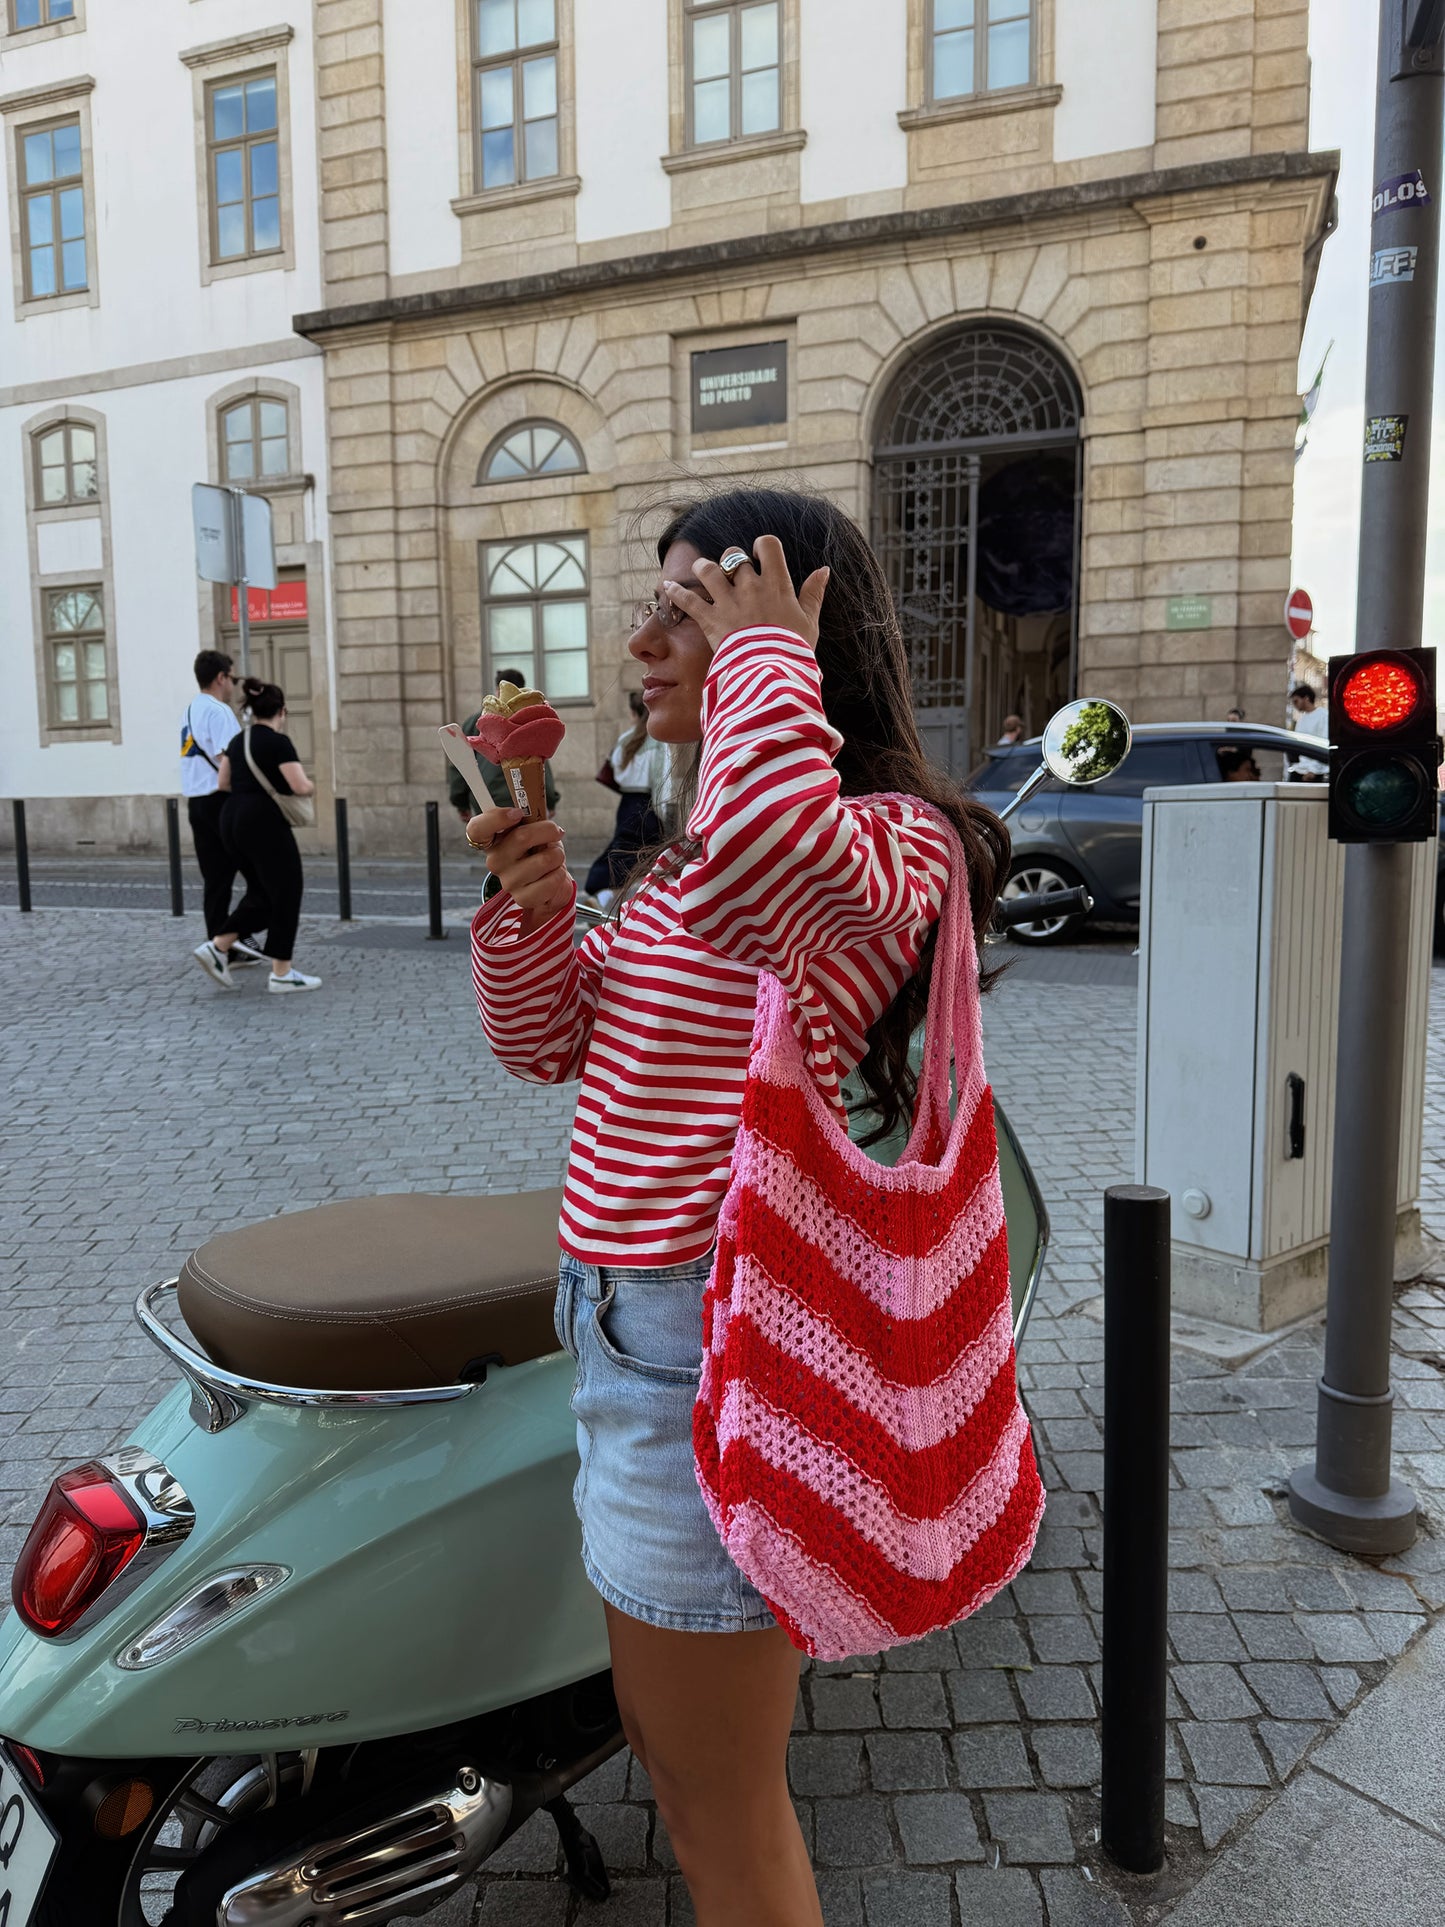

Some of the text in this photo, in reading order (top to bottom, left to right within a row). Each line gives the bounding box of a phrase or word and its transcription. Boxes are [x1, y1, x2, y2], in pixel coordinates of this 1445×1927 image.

[700, 367, 777, 391] UNIVERSIDADE
[716, 386, 751, 404] PORTO
[172, 1710, 350, 1735] Primavera
